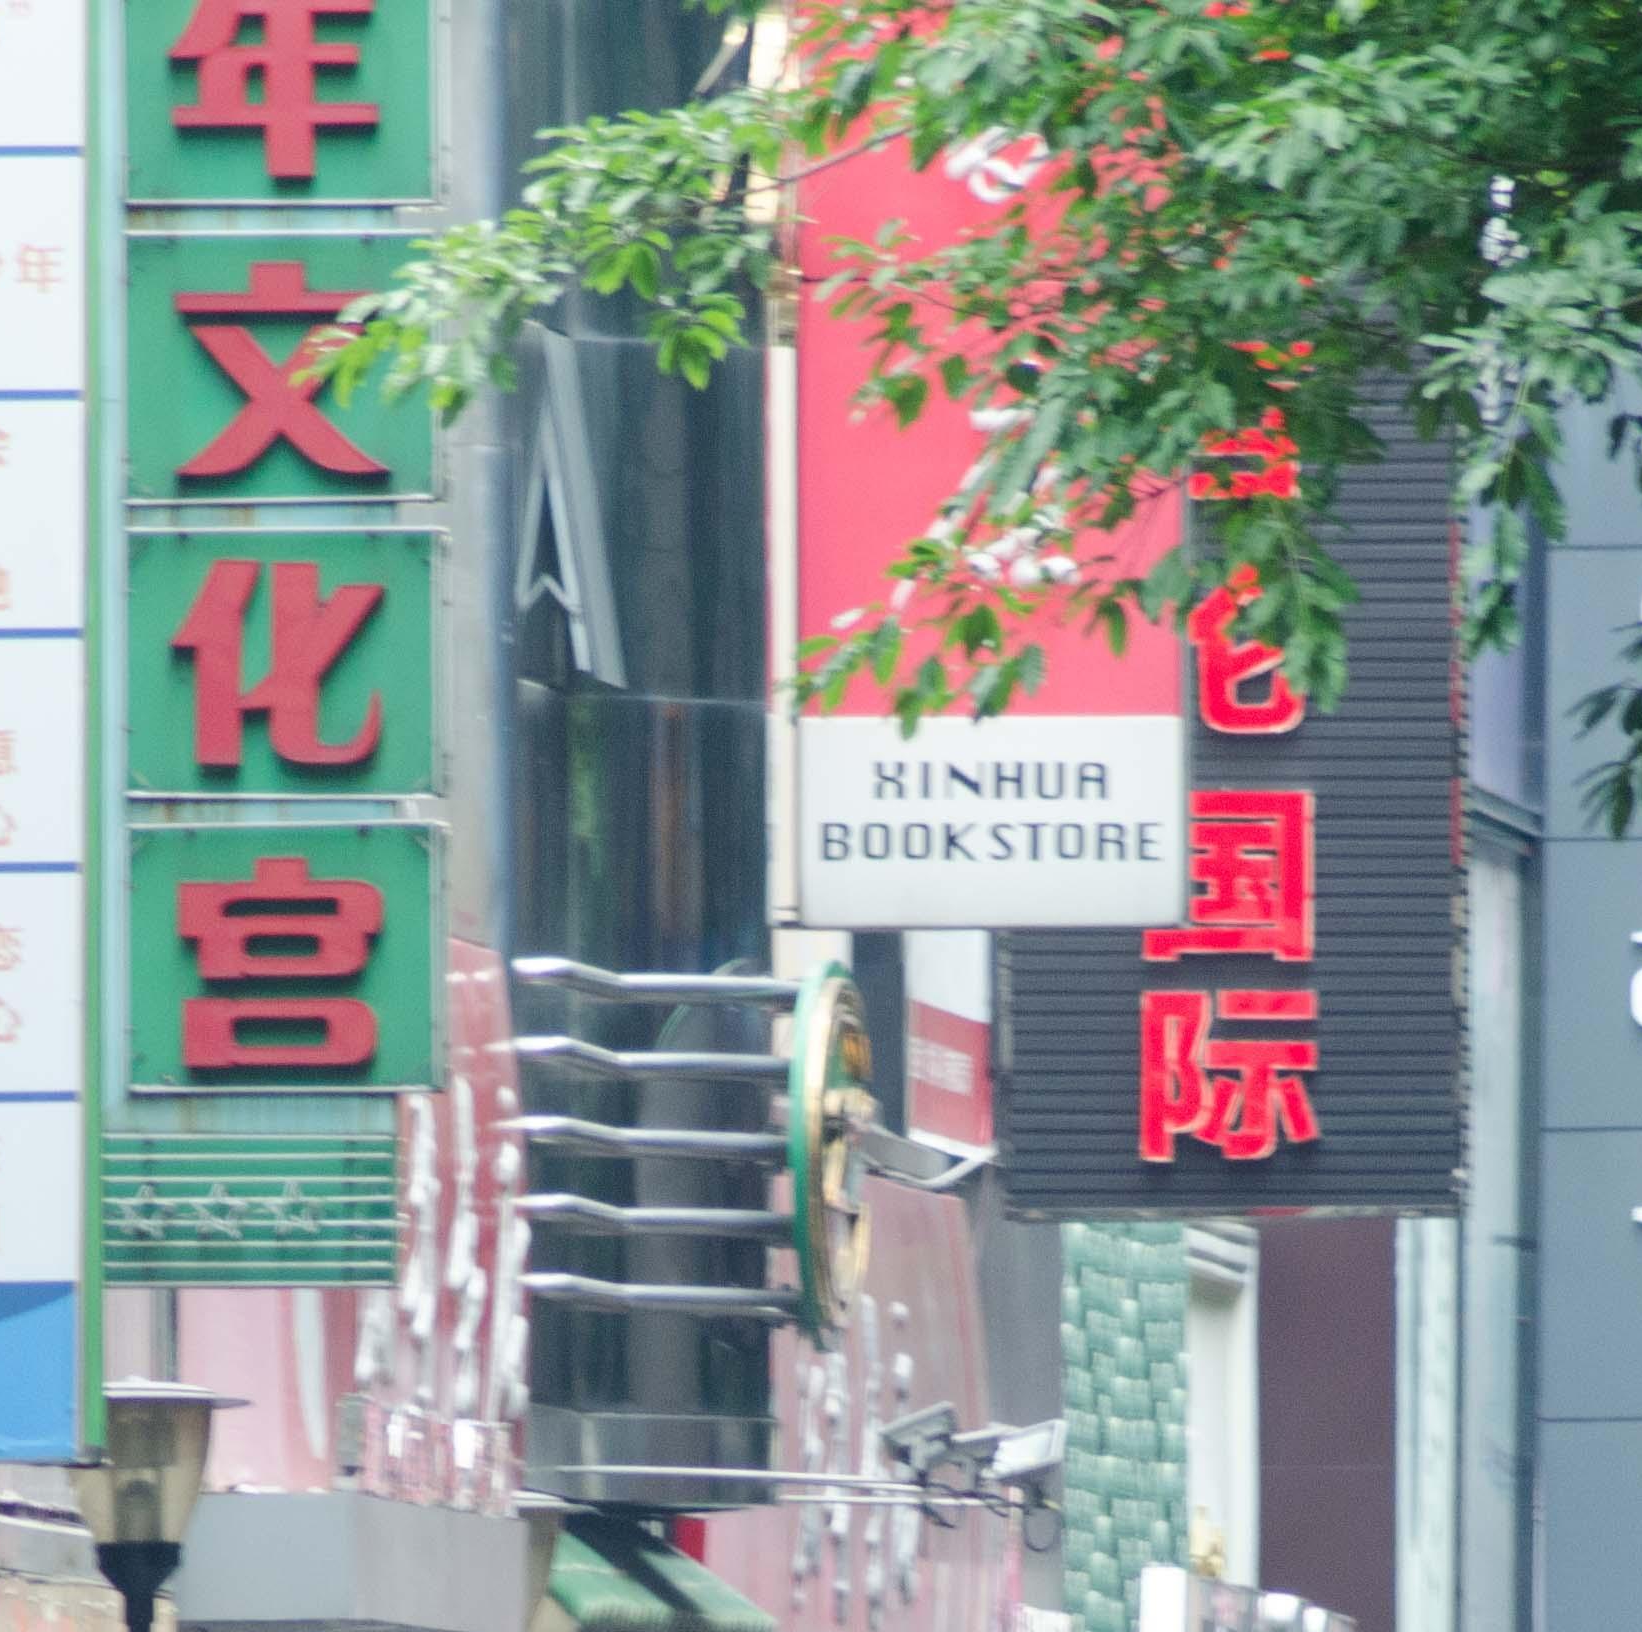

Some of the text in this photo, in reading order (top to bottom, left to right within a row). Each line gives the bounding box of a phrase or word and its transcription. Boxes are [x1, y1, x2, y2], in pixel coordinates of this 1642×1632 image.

[167, 0, 393, 1070] 年文化宫
[872, 760, 1112, 800] XINHUA
[821, 821, 1166, 863] BOOKSTORE
